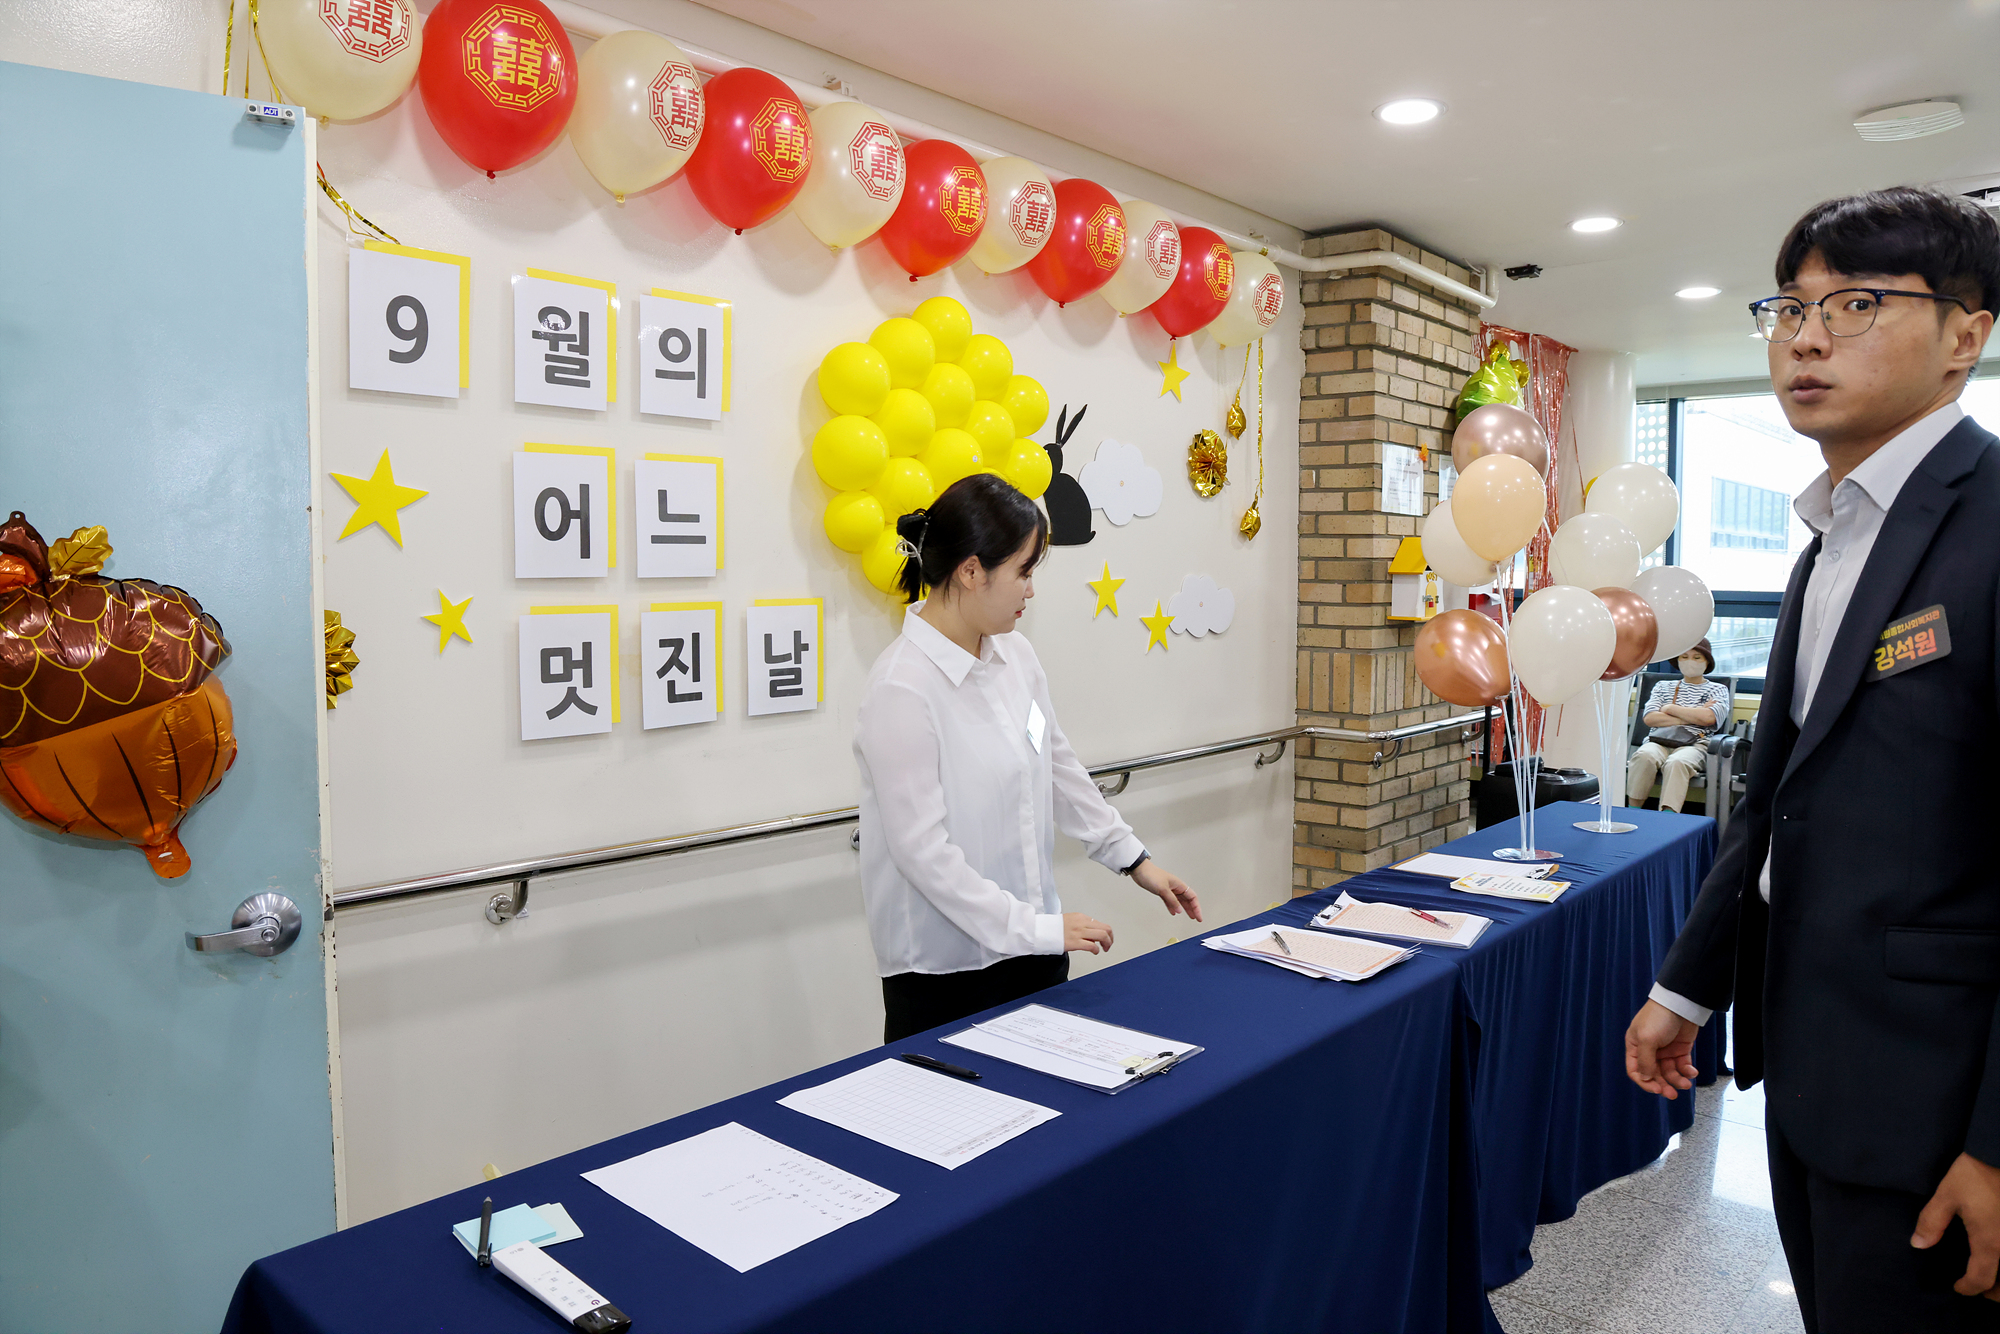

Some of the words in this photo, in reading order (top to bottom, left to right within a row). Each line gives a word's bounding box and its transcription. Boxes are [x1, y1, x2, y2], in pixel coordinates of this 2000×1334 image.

[264, 107, 278, 116] ADT
[534, 484, 707, 560] 어느
[764, 630, 810, 699] 날
[1874, 628, 1938, 671] 강석원
